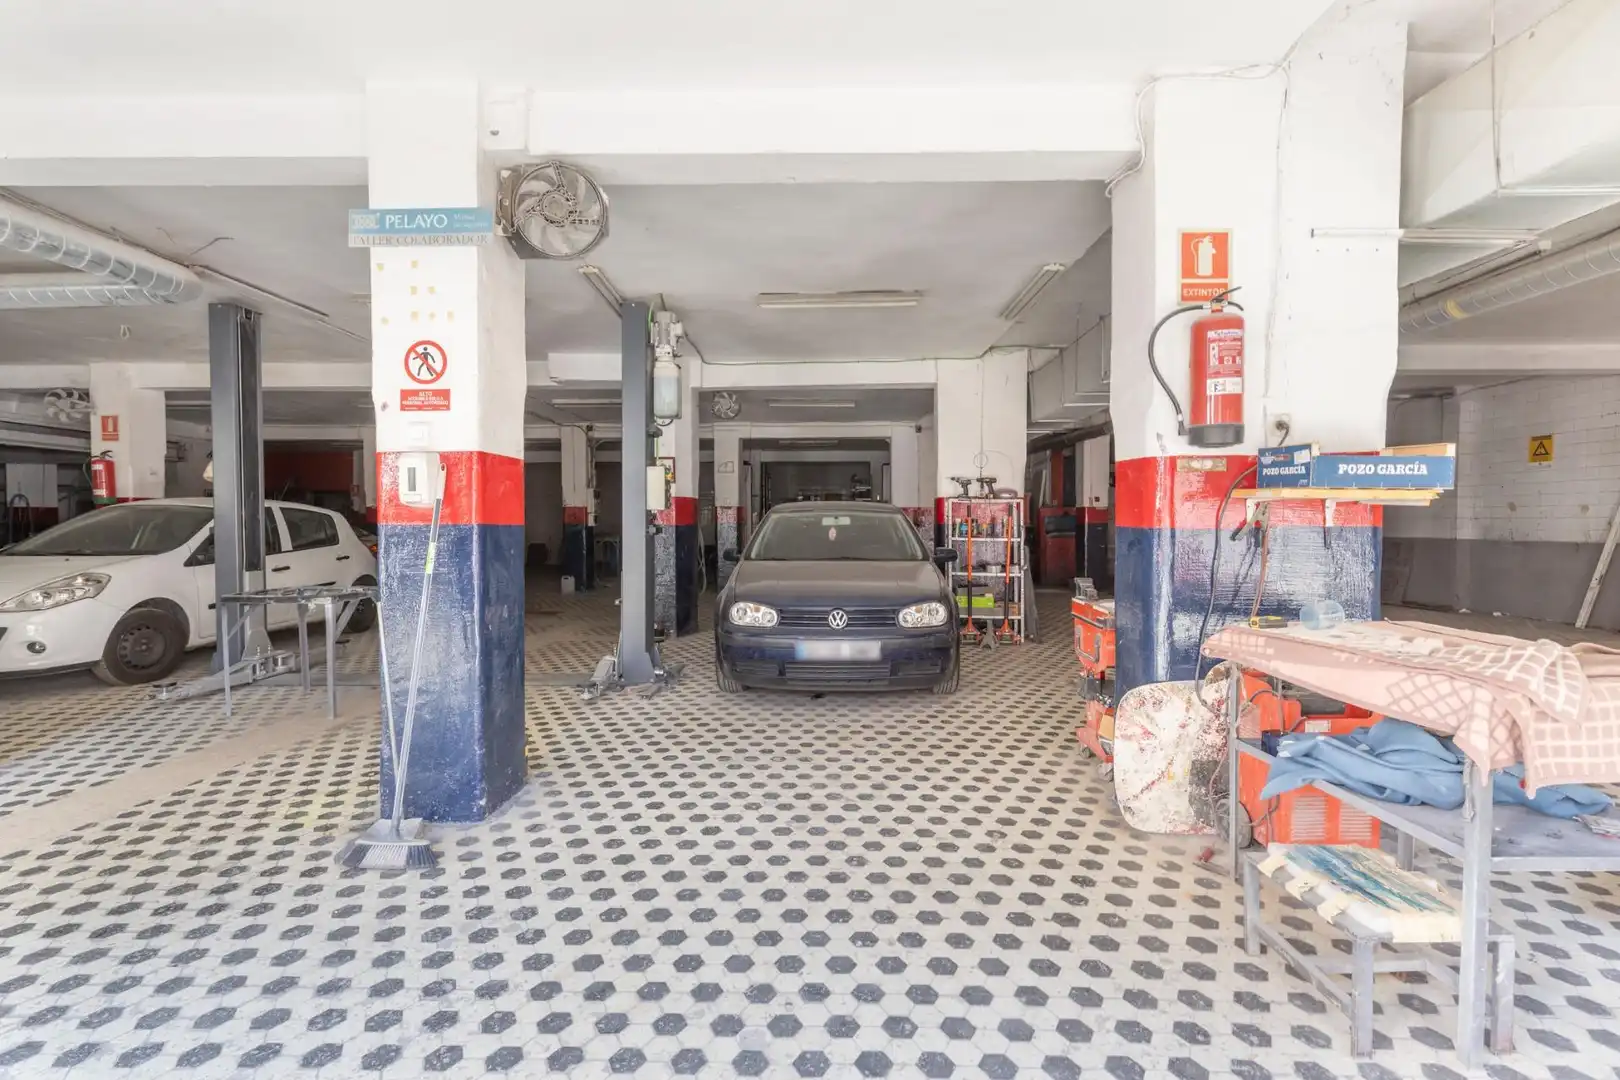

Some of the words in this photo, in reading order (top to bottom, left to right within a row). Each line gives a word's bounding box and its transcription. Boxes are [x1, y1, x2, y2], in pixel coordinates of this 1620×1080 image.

[385, 213, 448, 229] PELAYO
[352, 234, 393, 246] TALLER
[396, 233, 489, 246] COLABORADOR
[1262, 467, 1280, 476] POZO
[1280, 464, 1307, 475] GARCÍA
[1338, 463, 1376, 475] POZO
[1377, 461, 1428, 475] GARCÍA
